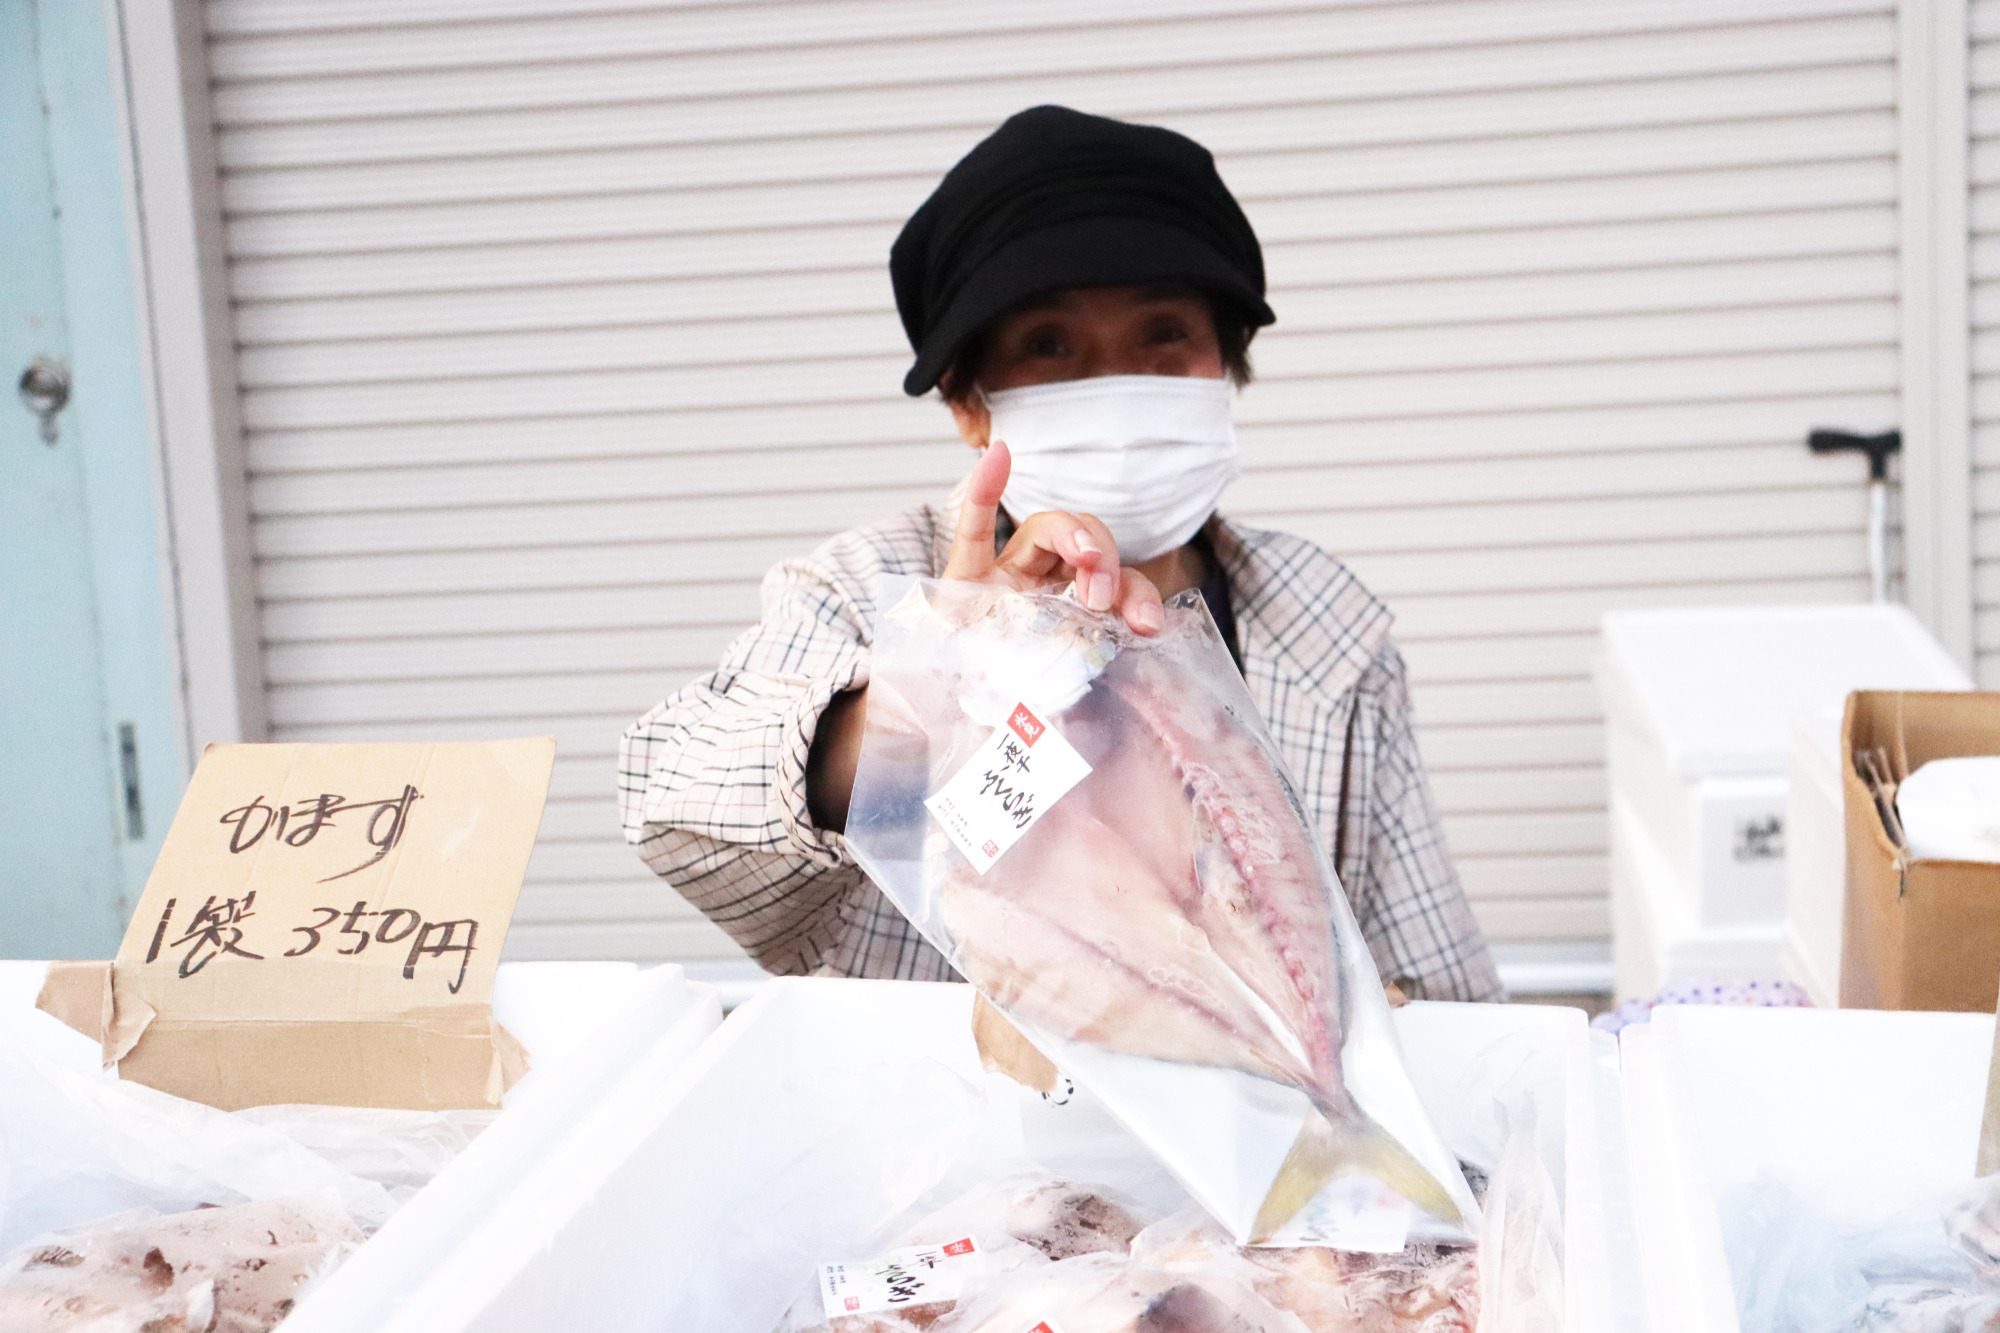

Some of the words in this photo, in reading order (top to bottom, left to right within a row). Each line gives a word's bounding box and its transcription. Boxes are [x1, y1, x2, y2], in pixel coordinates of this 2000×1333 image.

[1013, 711, 1040, 742] 氷見
[996, 733, 1031, 773] 一夜干
[979, 765, 1035, 829] ふくらぎ
